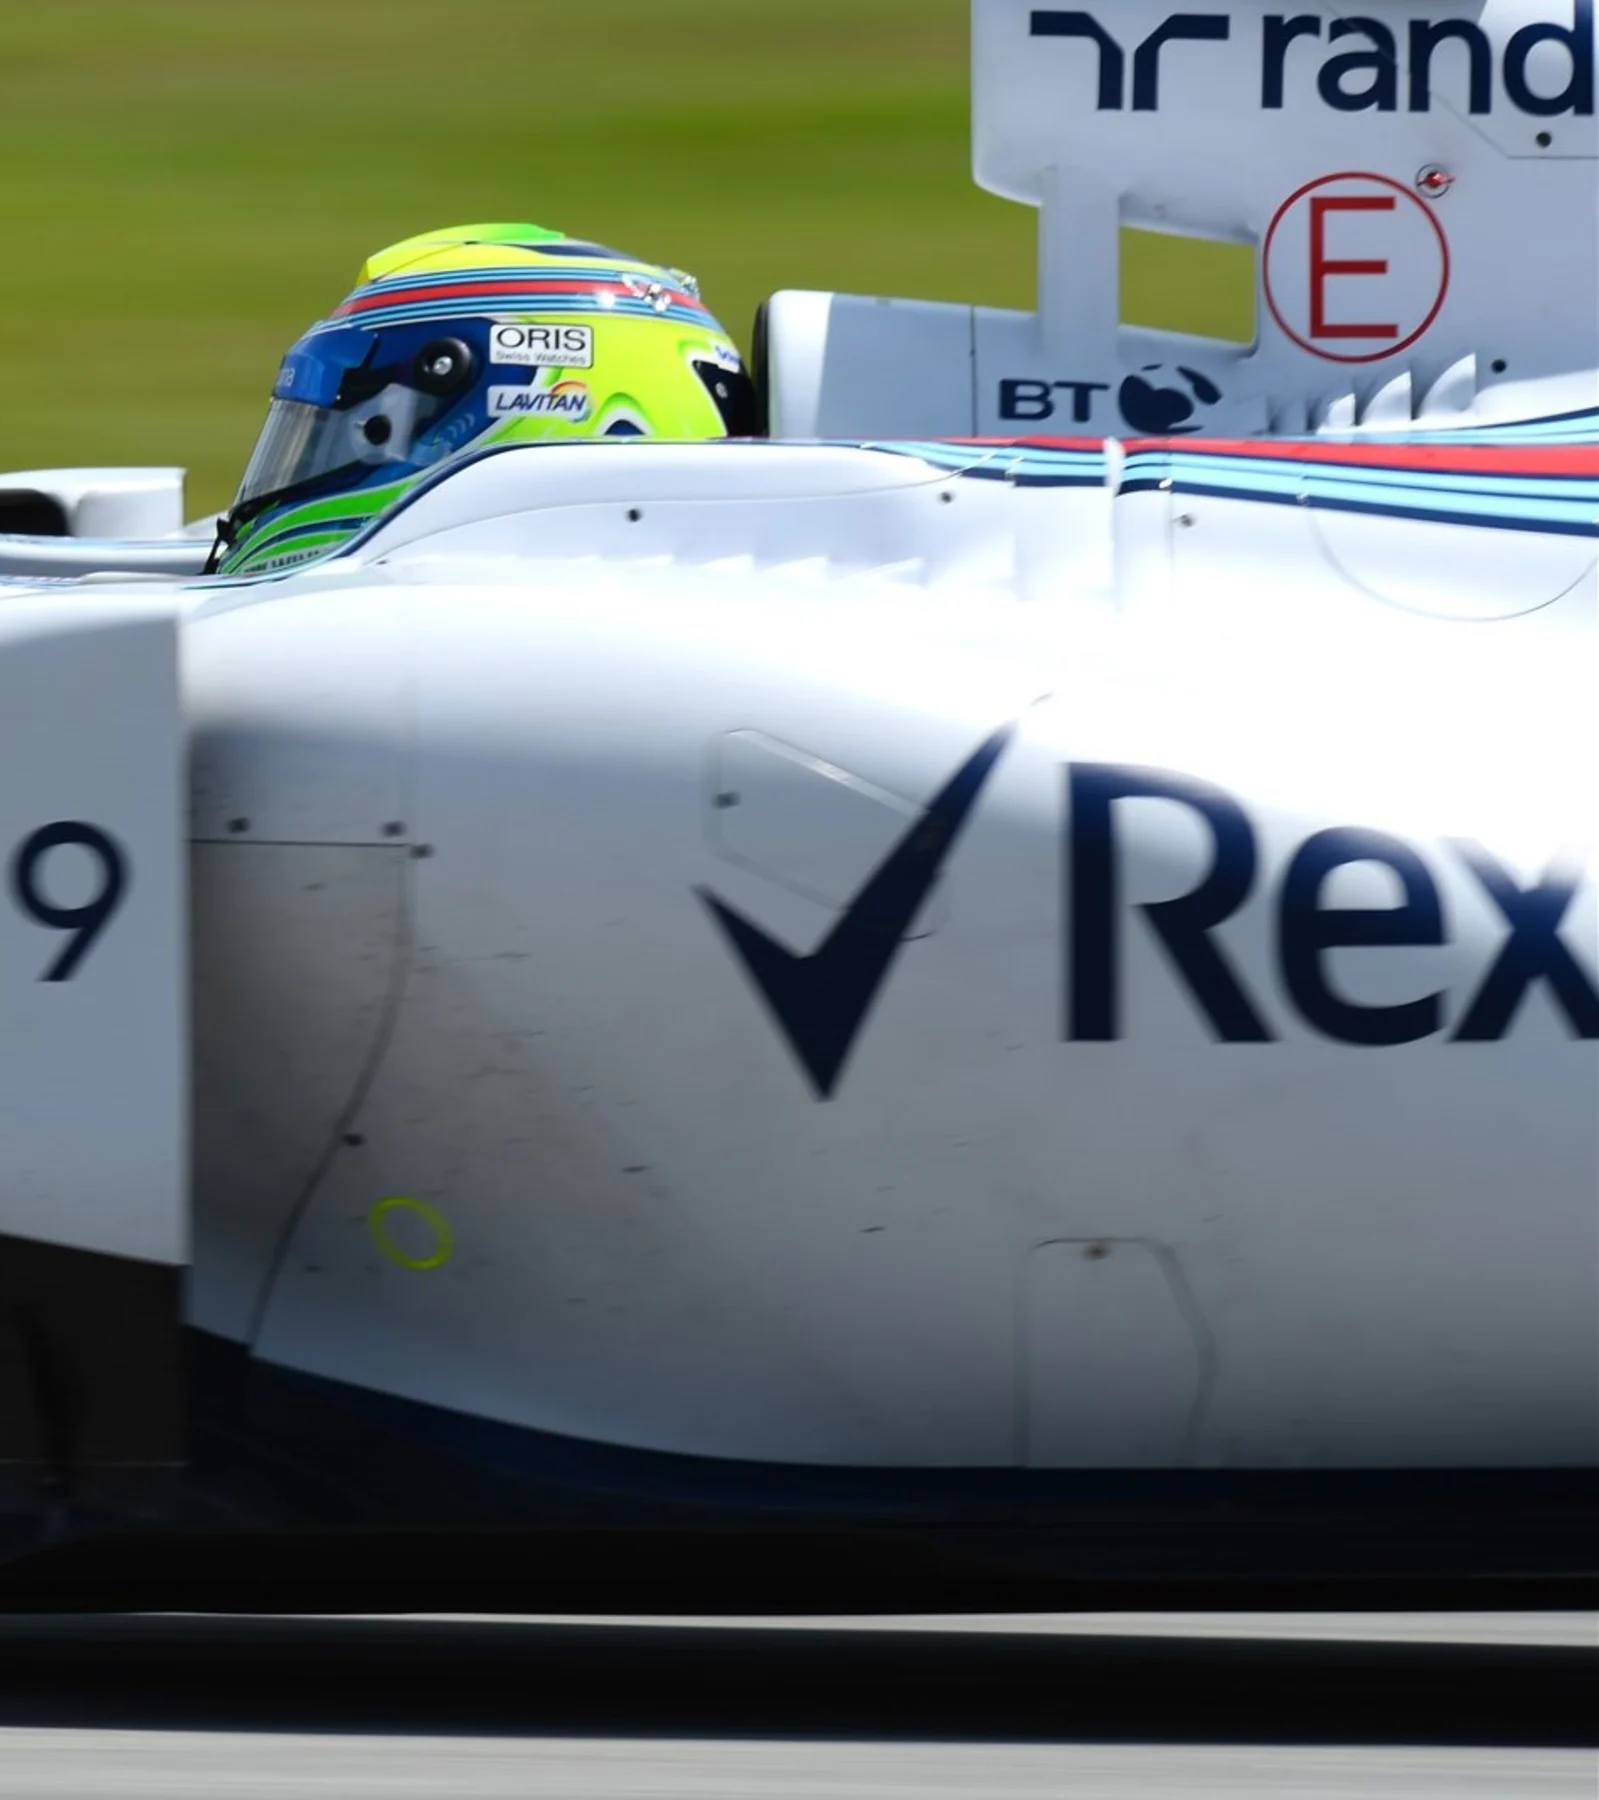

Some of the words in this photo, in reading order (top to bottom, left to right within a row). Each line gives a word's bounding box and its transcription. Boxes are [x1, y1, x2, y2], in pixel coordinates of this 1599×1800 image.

[1309, 196, 1399, 339] E
[496, 327, 586, 351] ORIS
[495, 392, 587, 411] LAVITAN
[998, 379, 1109, 421] BT
